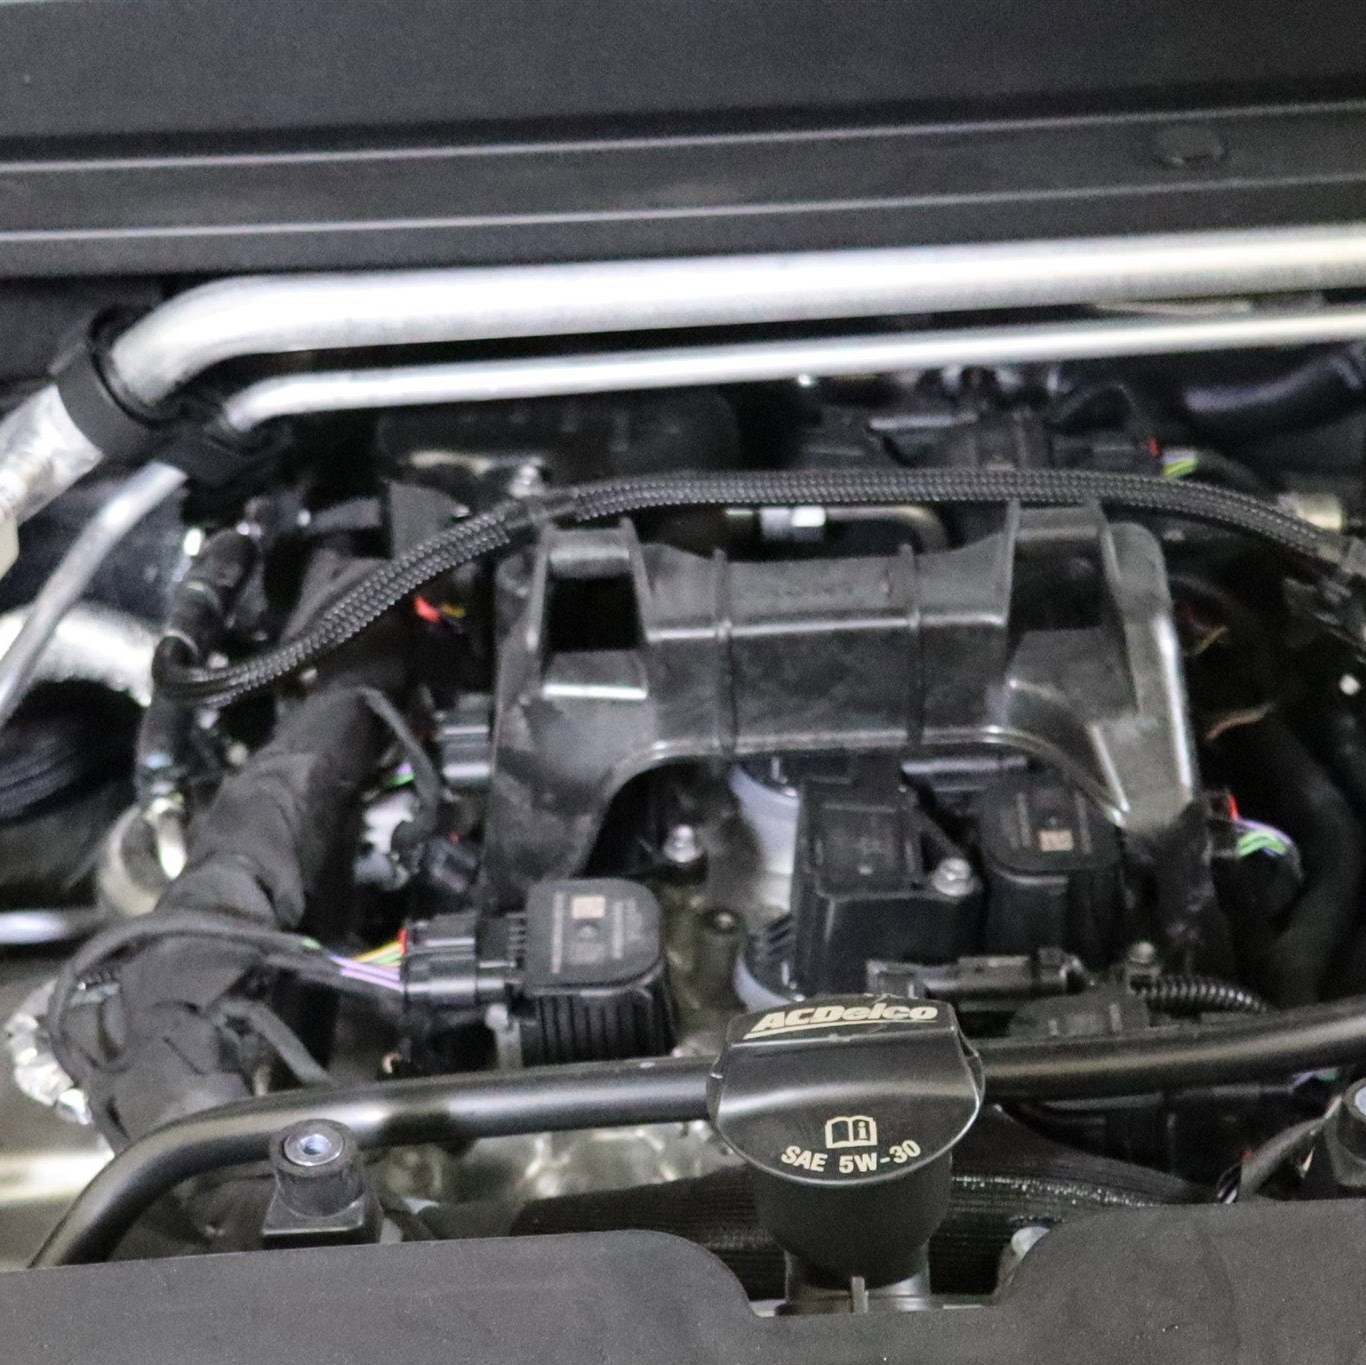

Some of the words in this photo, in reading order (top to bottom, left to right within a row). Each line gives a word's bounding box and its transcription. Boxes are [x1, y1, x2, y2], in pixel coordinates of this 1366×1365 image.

[747, 1002, 939, 1036] ACDelco
[780, 1145, 829, 1173] SAE
[838, 1140, 922, 1174] 5W-30
